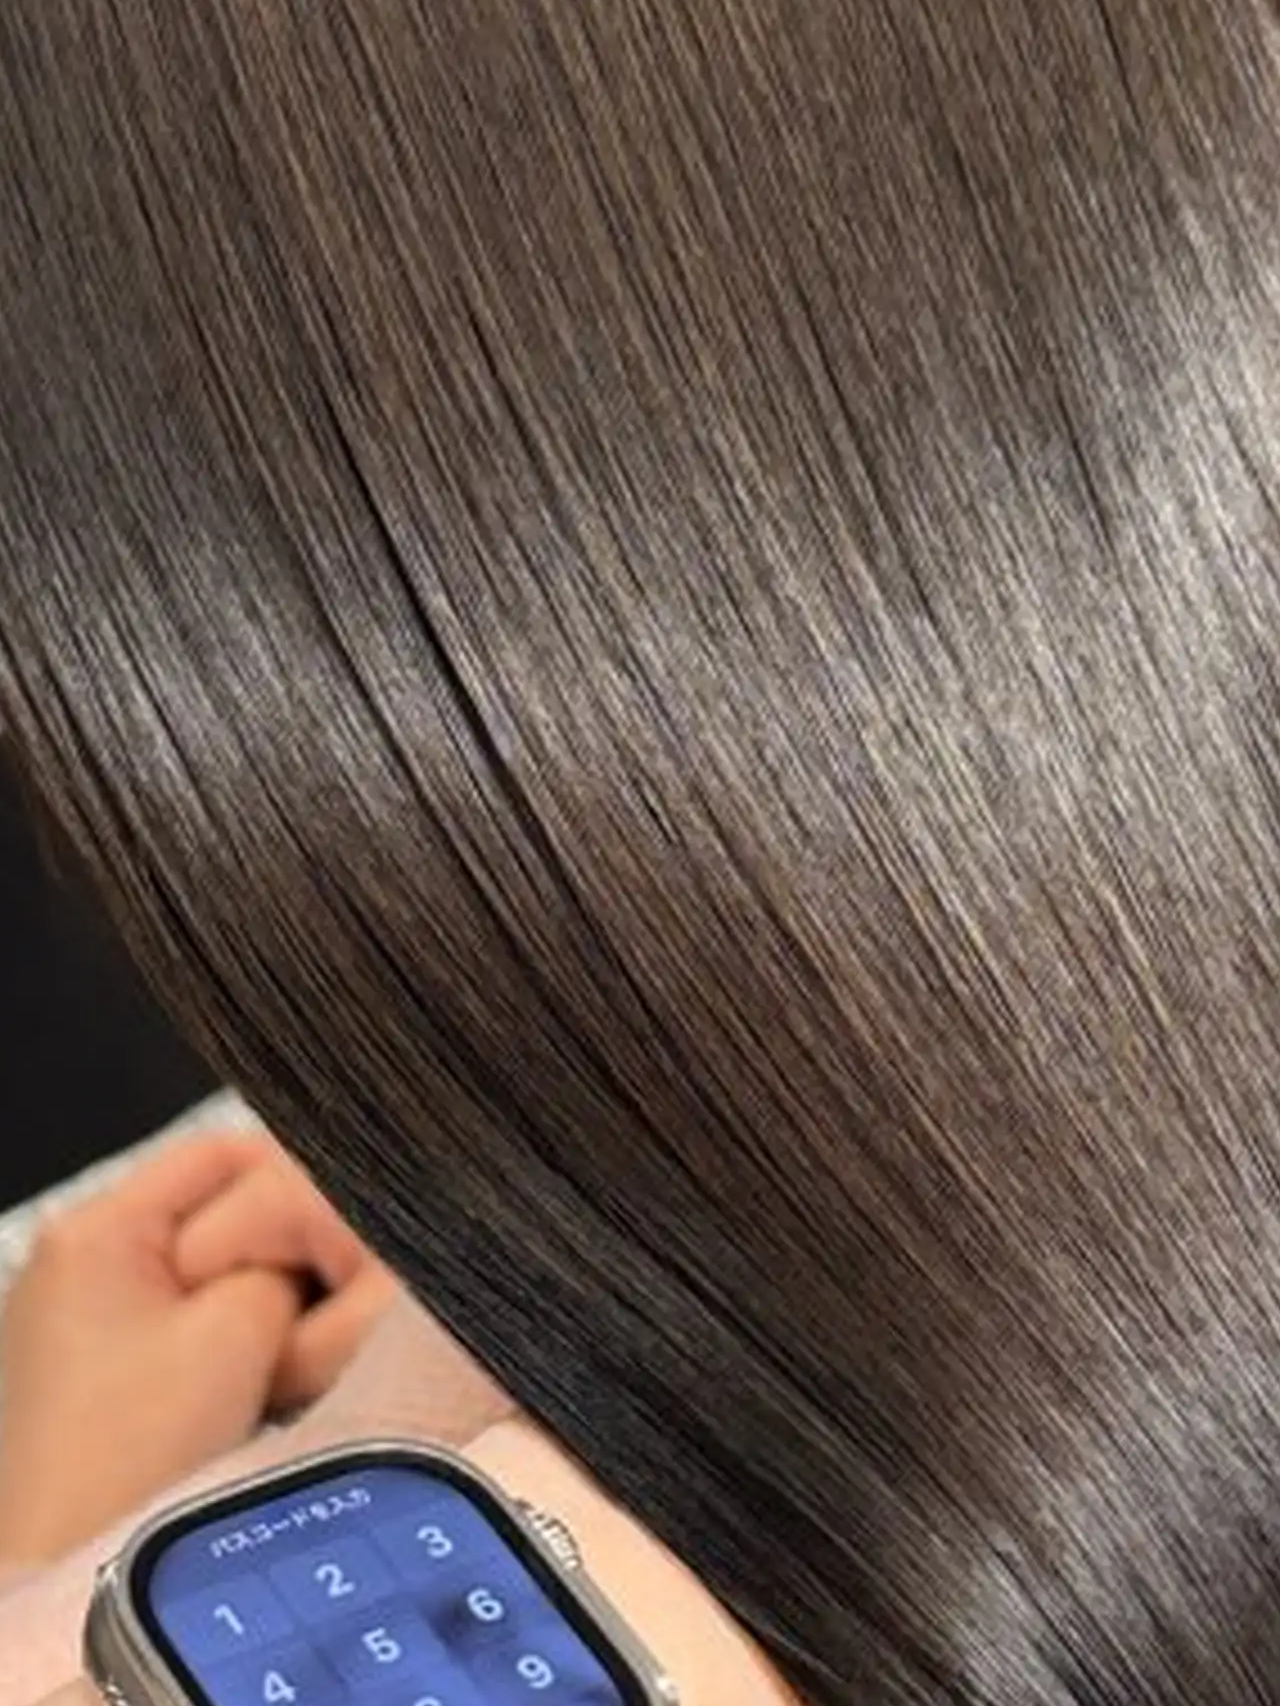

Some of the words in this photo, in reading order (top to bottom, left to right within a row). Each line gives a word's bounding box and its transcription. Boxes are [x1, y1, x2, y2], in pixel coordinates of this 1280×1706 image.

[215, 1605, 245, 1635] 1
[315, 1564, 354, 1598] 2
[417, 1525, 453, 1558] 3
[263, 1671, 296, 1704] 4
[362, 1628, 401, 1663] 5
[466, 1589, 504, 1622] 6
[517, 1655, 554, 1689] 9
